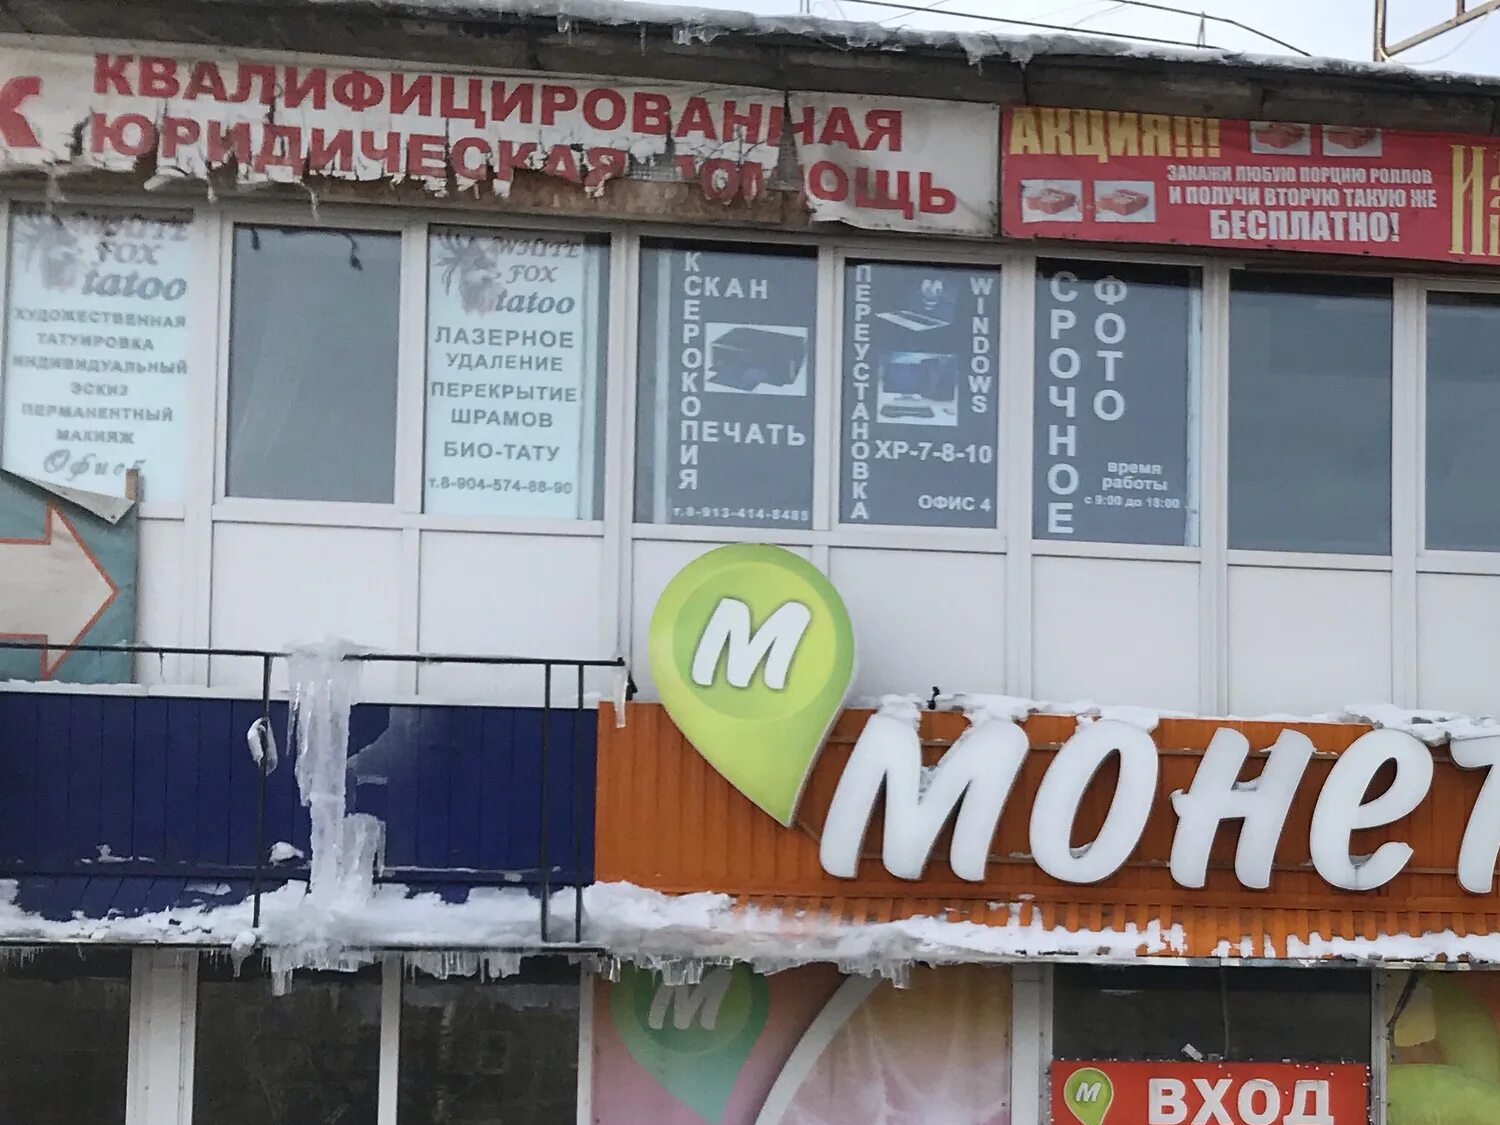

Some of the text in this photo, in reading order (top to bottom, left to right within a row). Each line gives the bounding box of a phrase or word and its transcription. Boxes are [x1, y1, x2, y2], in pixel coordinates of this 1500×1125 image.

[94, 52, 902, 152] КВАЛИФИЦИРОВАННАЯ
[1009, 107, 1221, 163] АКЦИЯ!!!
[90, 112, 628, 187] ЮРИДИЧЕСКАЯ
[1167, 165, 1433, 185] ЗАКАЖИ ЛЮБУЮ ПОРЦИЮ РОЛЛОВ
[1169, 186, 1437, 208] И ПОЛУЧИ ВТОРУЮ ТАКУЮ ЖЕ
[1210, 209, 1400, 242] БЕСПЛАТНО!
[505, 264, 558, 284] FOX
[14, 308, 186, 328] ХУДОЖЕСТВЕННАЯ
[37, 333, 154, 351] ТАТУИРОВКА
[435, 326, 574, 349] ЛАЗЕРНОЕ
[968, 277, 994, 413] WINDOWS
[1093, 275, 1128, 421] ФОТО
[13, 355, 188, 374] ИНДИВИДУАЛЬНЫЙ
[446, 352, 563, 372] УДАЛЕНИЕ
[70, 381, 129, 396] ЭСКИЗ
[431, 381, 577, 402] ПЕРЕКРЫТИЕ
[850, 264, 872, 520] ПЕРЕУСТАНОВКА
[22, 403, 173, 422] ПЕРМАНЕНТНЫЙ
[1047, 271, 1081, 534] СРОЧНОЕ
[451, 408, 553, 428] ШРАМОВ
[56, 428, 135, 444] МАКИЯЖ
[444, 441, 560, 462] БИО-ТАТУ
[1107, 461, 1162, 475] время
[1102, 476, 1168, 491] работы
[918, 494, 991, 512] ОФИС 4
